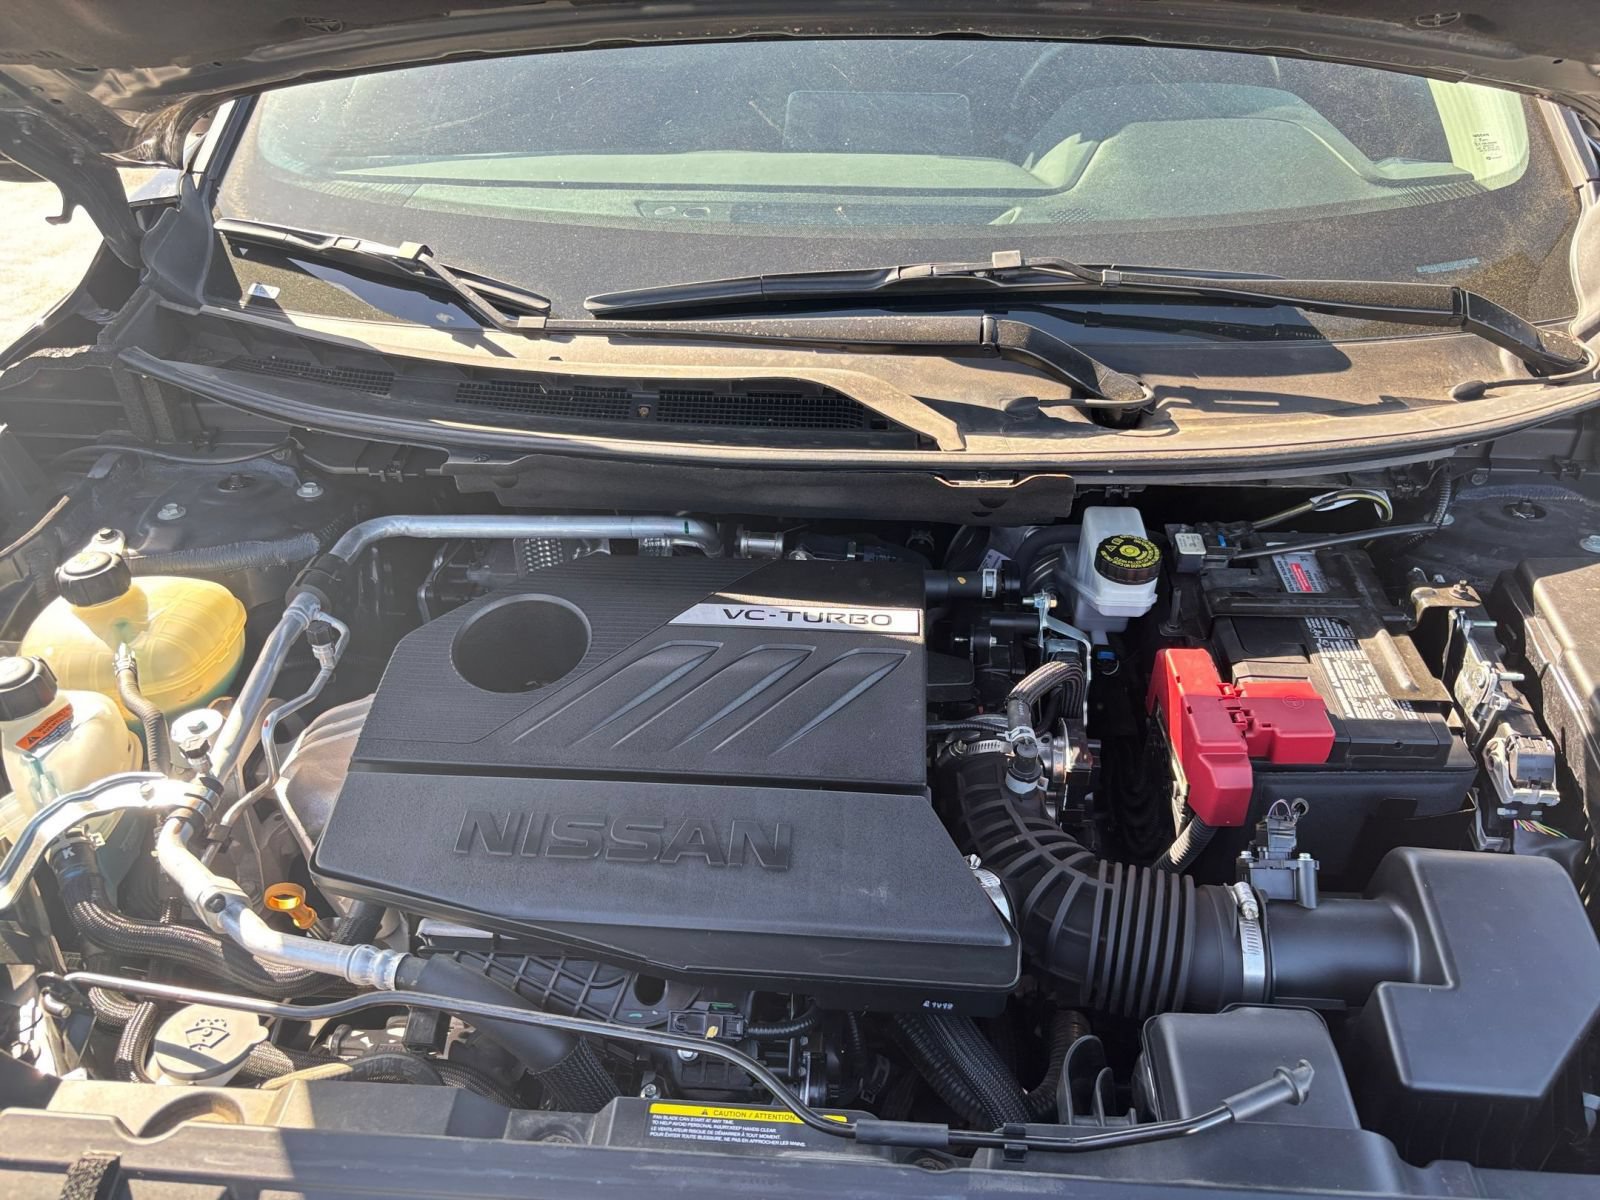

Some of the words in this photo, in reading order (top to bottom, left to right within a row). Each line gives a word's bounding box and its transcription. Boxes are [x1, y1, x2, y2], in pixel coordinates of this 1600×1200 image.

[722, 608, 893, 627] VC-TURBO
[453, 808, 795, 872] NISSAN
[713, 1109, 747, 1119] CAUTION
[754, 1112, 796, 1121] ATTENTION
